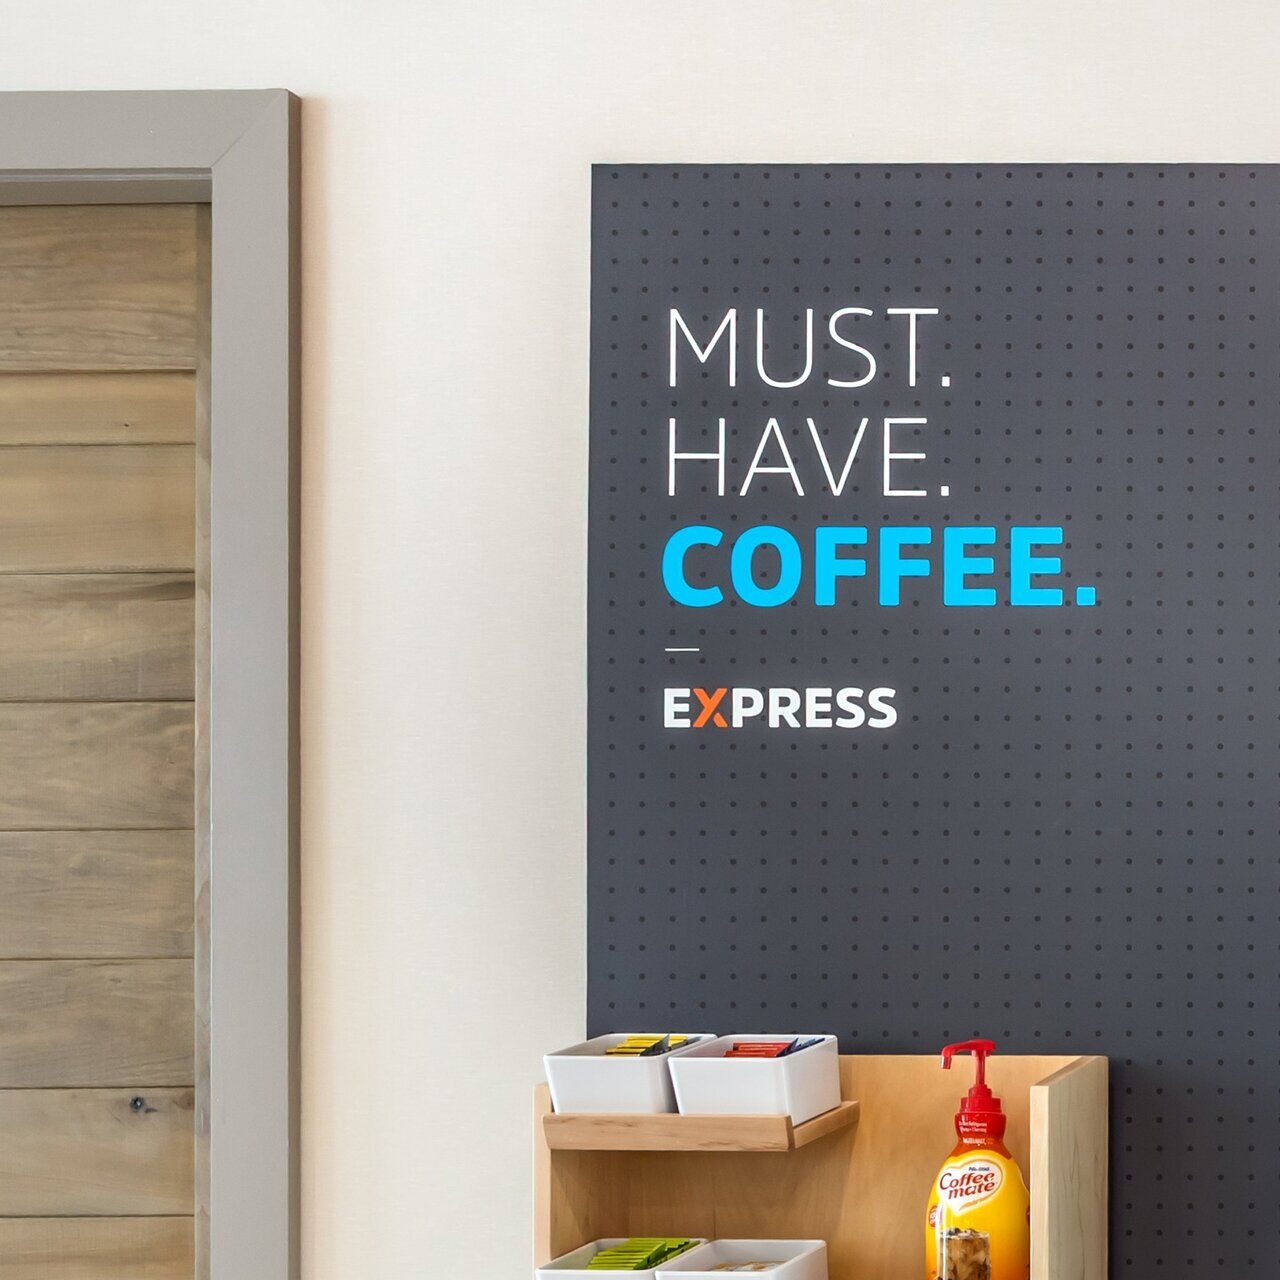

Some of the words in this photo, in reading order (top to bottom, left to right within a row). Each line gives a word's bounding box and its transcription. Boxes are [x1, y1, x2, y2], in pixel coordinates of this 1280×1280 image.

[669, 307, 951, 388] MUST.
[669, 416, 951, 497] HAVE.
[661, 524, 1097, 608] COFFEE.
[663, 687, 898, 728] EXPRESS
[940, 1171, 995, 1190] Coffee
[948, 1181, 996, 1200] mate
